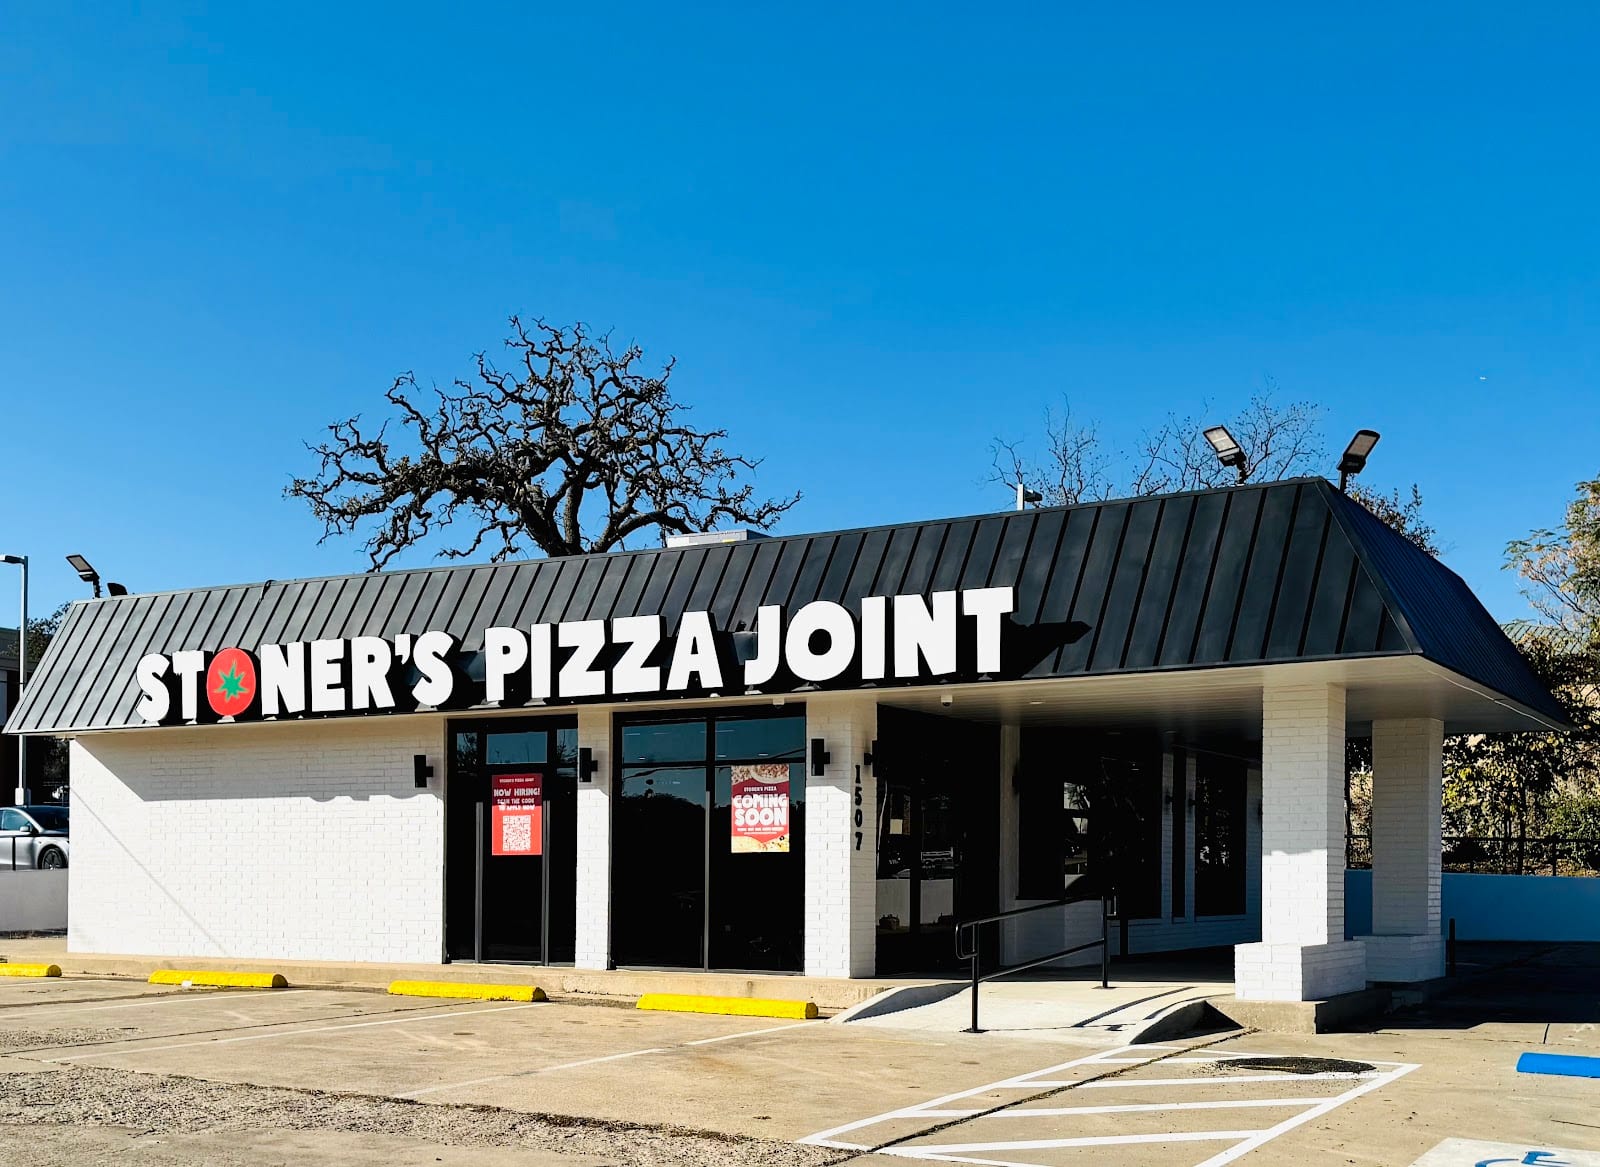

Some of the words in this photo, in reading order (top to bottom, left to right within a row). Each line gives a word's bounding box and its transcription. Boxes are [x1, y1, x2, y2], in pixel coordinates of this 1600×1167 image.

[135, 631, 457, 726] STONER'S
[485, 609, 723, 702] PIZZA
[743, 586, 1015, 687] JOINT
[493, 788, 511, 797] NOW
[514, 787, 540, 796] HIRING!
[733, 793, 787, 808] COMING
[734, 807, 787, 826] SOON
[854, 764, 863, 851] 1507
